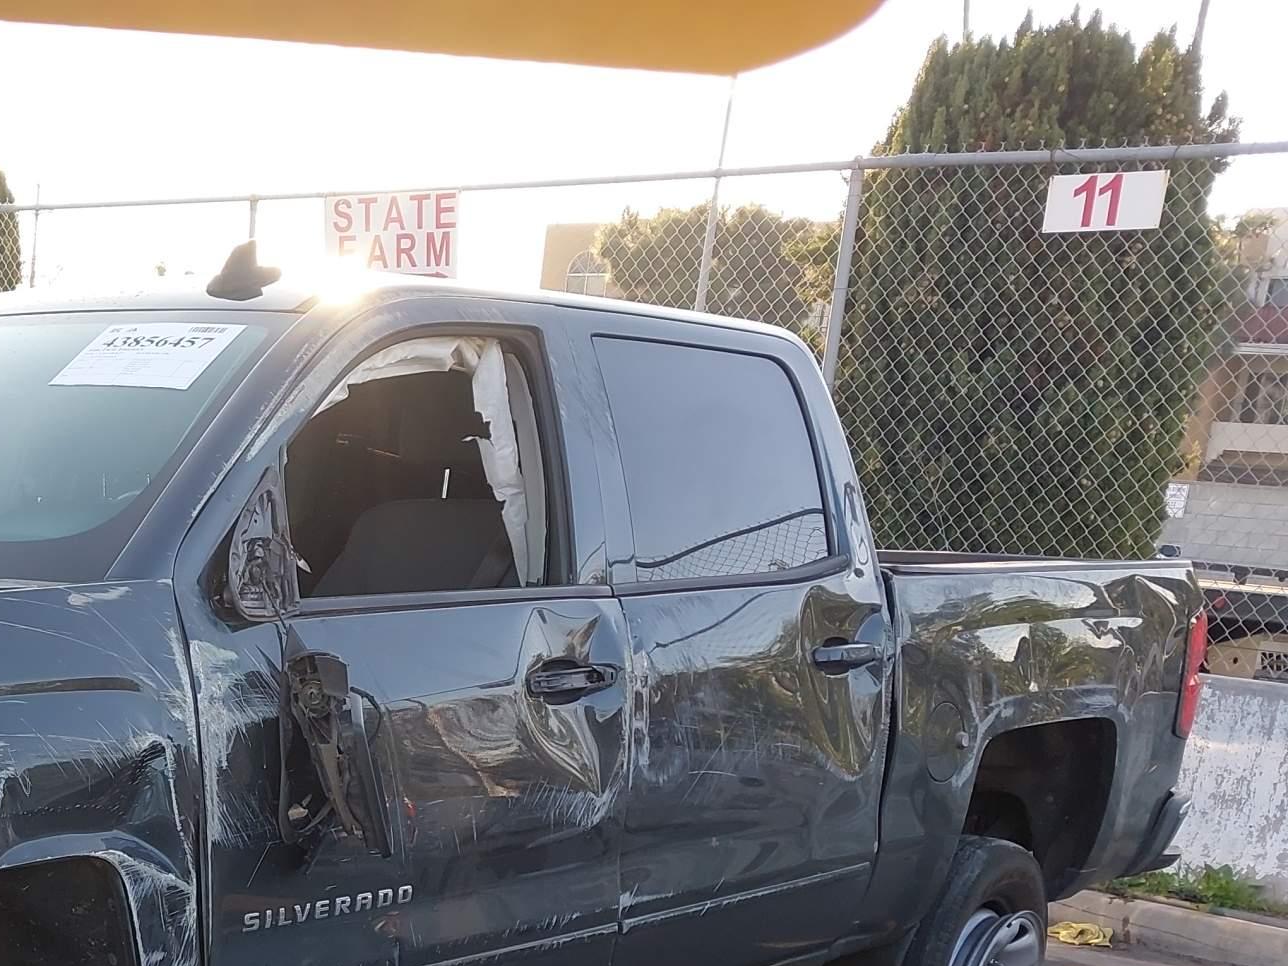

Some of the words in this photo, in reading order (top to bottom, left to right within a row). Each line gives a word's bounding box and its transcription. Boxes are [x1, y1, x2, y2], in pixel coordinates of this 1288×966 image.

[332, 193, 457, 232] STATE
[1073, 173, 1123, 227] 11
[338, 231, 451, 269] FARM
[103, 335, 215, 349] 43856457
[242, 884, 414, 933] SILVERADO
